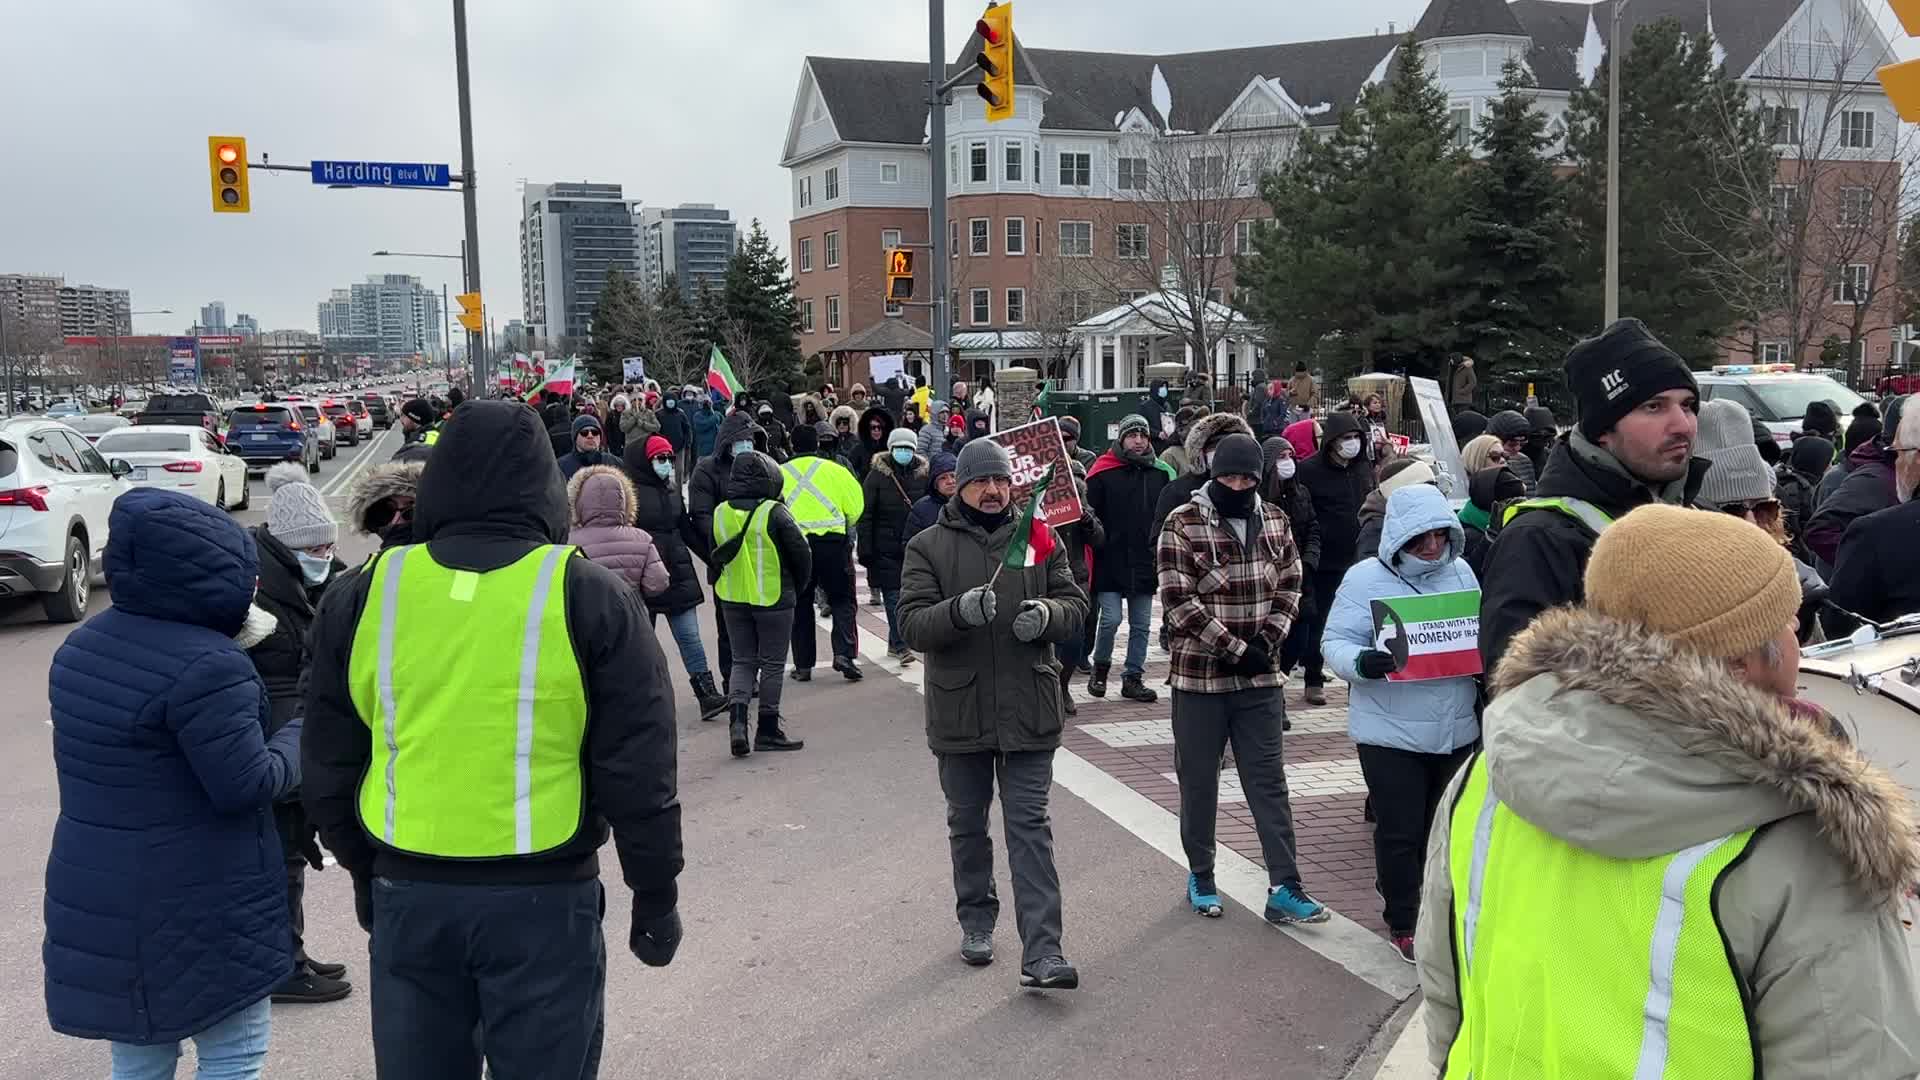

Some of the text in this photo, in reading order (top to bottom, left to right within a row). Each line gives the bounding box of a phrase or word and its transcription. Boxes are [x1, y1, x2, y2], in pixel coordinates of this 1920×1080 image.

[324, 161, 437, 185] Harding Blvd W
[1009, 455, 1036, 473] UR
[1009, 464, 1048, 486] OIC
[1424, 621, 1445, 630] STAND
[1447, 619, 1466, 628] WITH
[1408, 630, 1453, 645] WOMEN
